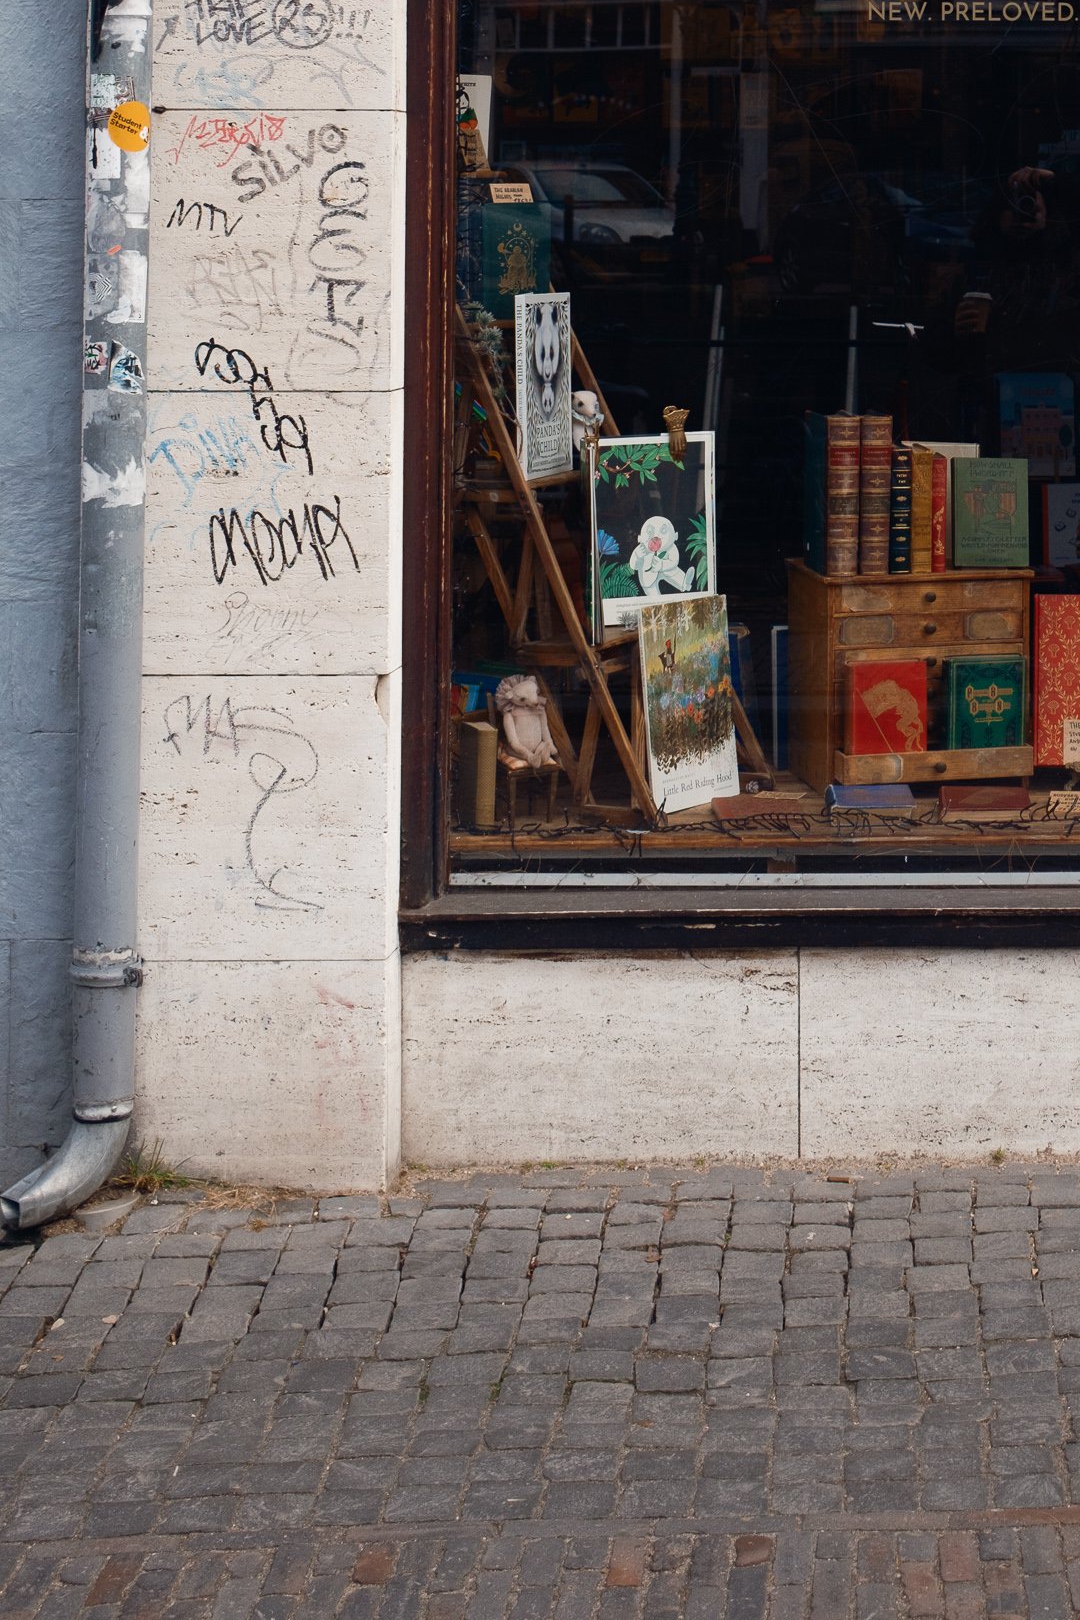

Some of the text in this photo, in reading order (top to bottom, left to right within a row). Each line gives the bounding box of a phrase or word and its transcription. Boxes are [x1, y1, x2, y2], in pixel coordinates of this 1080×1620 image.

[867, 1, 933, 21] NEW.
[940, 1, 1080, 21] PRELOVED.
[110, 118, 138, 136] Starter
[113, 111, 142, 130] Student
[536, 423, 561, 439] PANDA'S
[539, 440, 559, 454] CHILD
[663, 784, 679, 797] Little
[680, 780, 693, 792] Red
[695, 777, 715, 789] Riding
[716, 770, 733, 783] Hood
